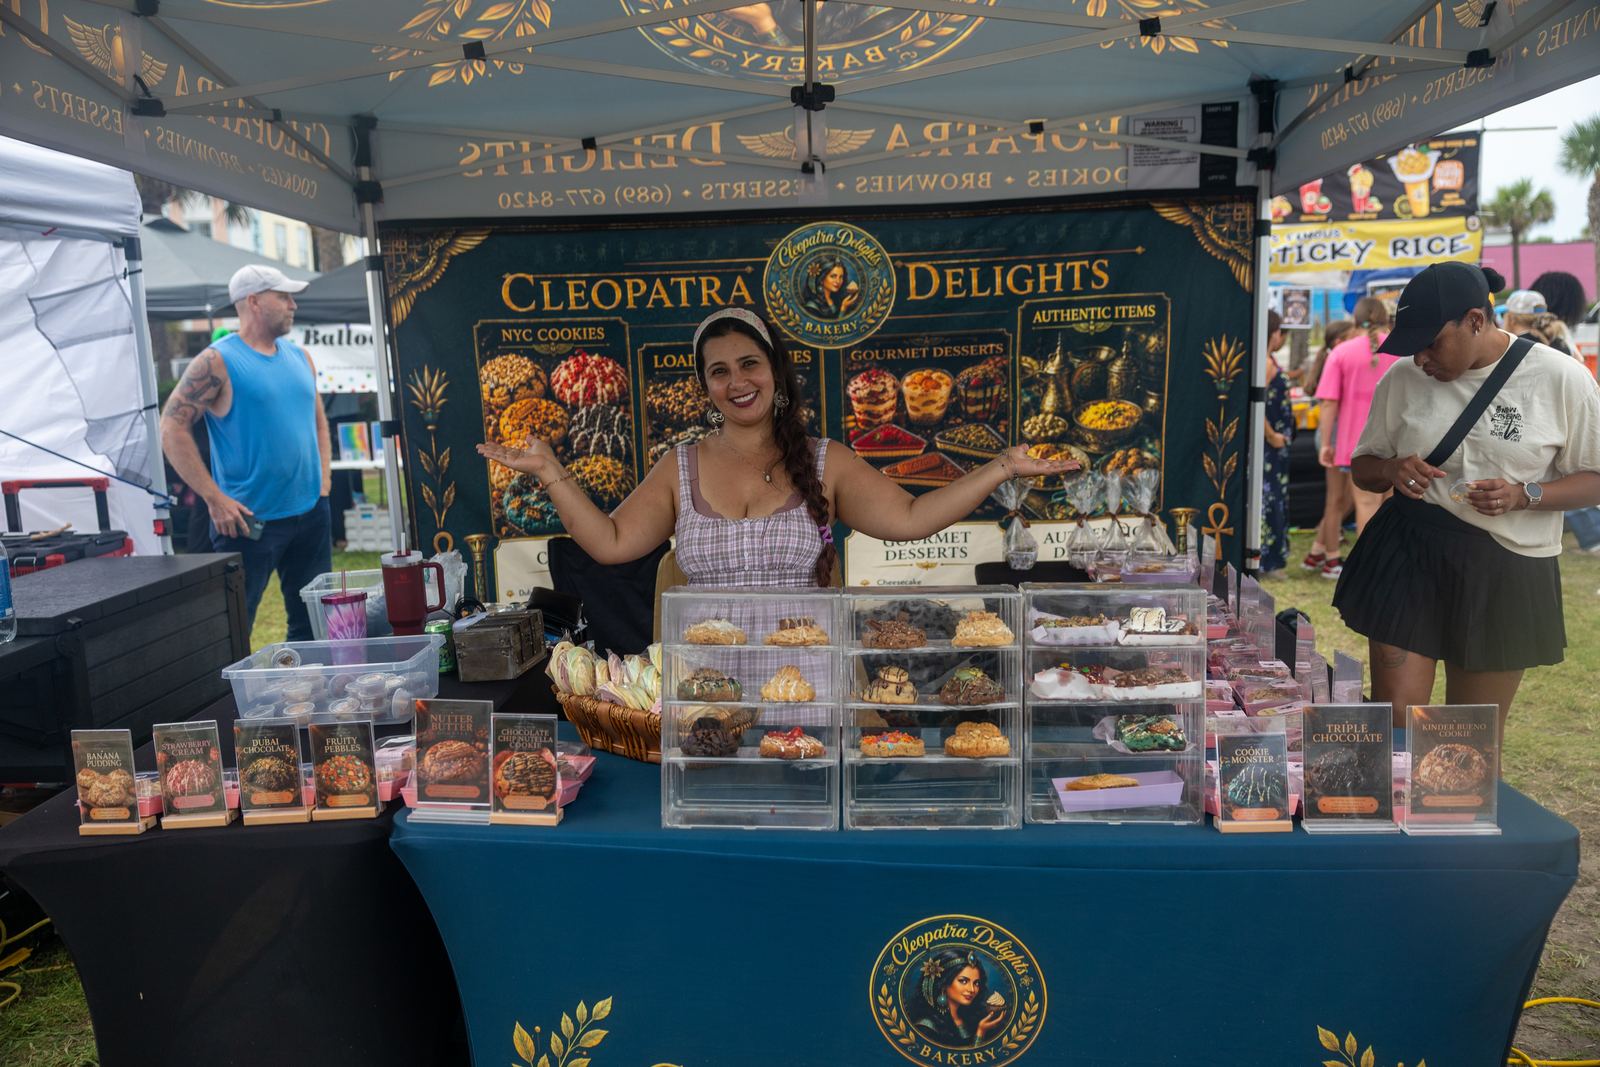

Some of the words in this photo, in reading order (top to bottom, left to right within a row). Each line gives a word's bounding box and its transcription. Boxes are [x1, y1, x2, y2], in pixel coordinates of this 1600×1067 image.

[1144, 120, 1179, 128] WARNING
[778, 230, 835, 268] Cleopatra
[836, 228, 882, 266] Delights
[1269, 241, 1374, 264] TICKY
[1392, 234, 1470, 257] RICE
[501, 273, 755, 312] CLEOPATRA
[906, 259, 1110, 300] DELIGHTS
[1033, 307, 1112, 323] AUTHENTIC
[1114, 304, 1156, 319] ITEMS
[805, 321, 858, 334] BAKERY
[502, 328, 533, 342] NYC
[537, 327, 605, 341] COOKIES
[851, 347, 929, 362] GOURMET
[932, 343, 1004, 358] DESSERTS
[885, 546, 969, 562] DESSERTS
[876, 577, 922, 587] Cheesecake
[430, 714, 473, 723] NUTTER
[431, 722, 473, 732] BUTTER
[1326, 723, 1369, 733] TRIPLE
[1422, 723, 1456, 732] KINDER
[1457, 723, 1487, 731] BUENO
[501, 728, 549, 737] CHOCOLATE
[252, 738, 279, 747] DUBAI
[326, 737, 358, 746] FRUITY
[497, 735, 516, 743] CHIP
[518, 735, 553, 744] NUTELLA
[1312, 733, 1383, 743] CHOCOLATE
[161, 740, 211, 751] STRAWBERRY
[243, 744, 290, 754] CHOCOLATE
[324, 744, 361, 753] PEBBLES
[86, 752, 120, 761] BANANA
[172, 748, 204, 756] CREAM
[1235, 748, 1269, 757] COOKIE
[86, 760, 122, 768] PUDDING
[1231, 755, 1274, 764] MONSTER
[892, 923, 968, 966] Cleopatra
[970, 925, 1028, 976] Delights
[920, 1045, 1001, 1065] BAKERY
